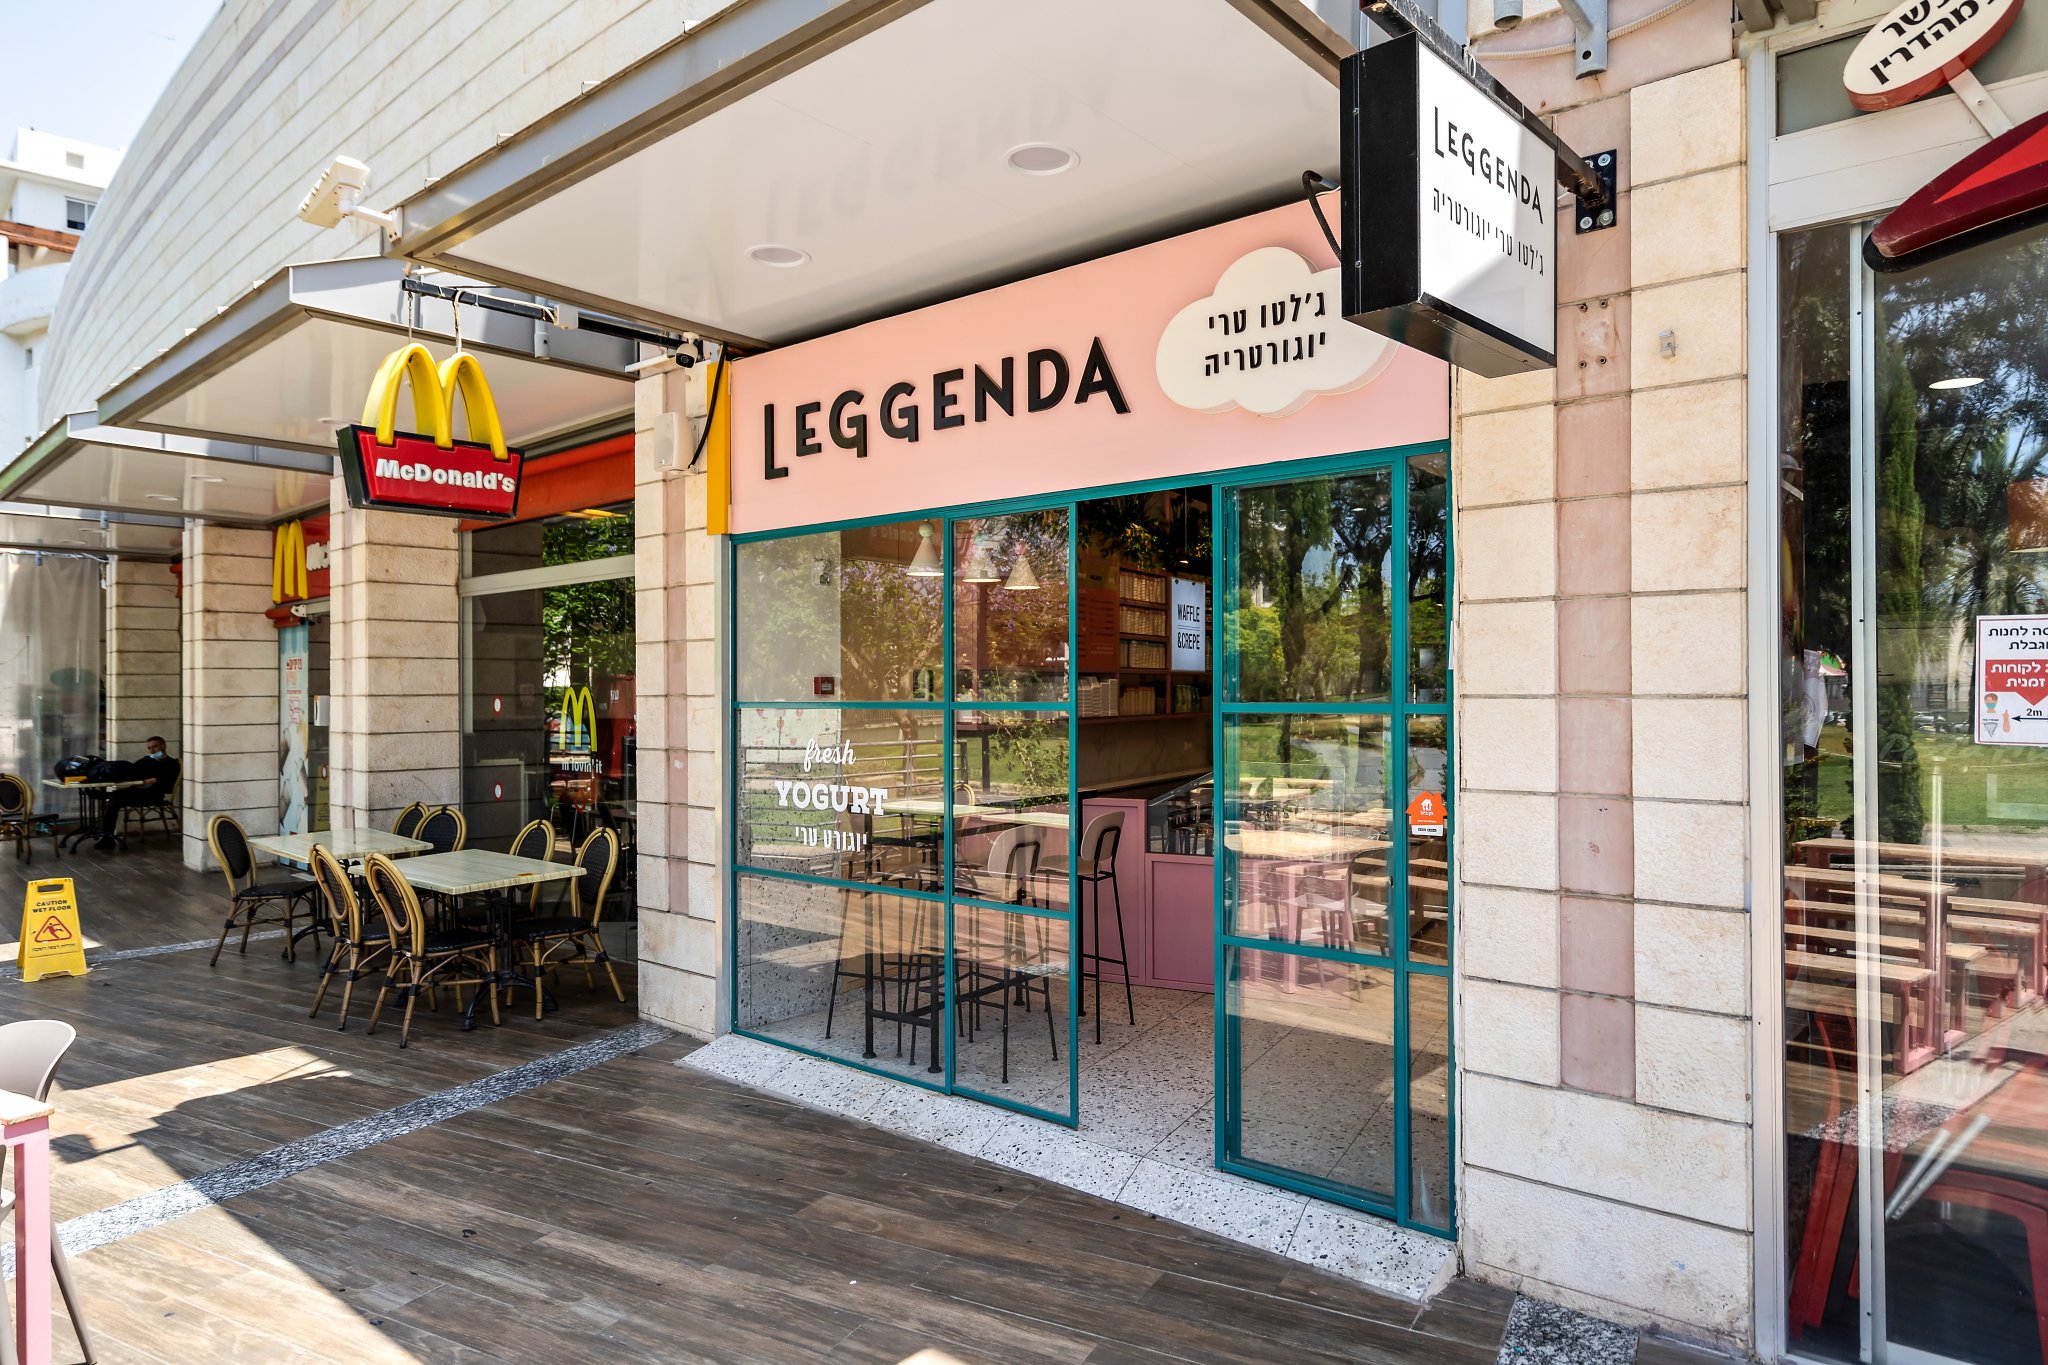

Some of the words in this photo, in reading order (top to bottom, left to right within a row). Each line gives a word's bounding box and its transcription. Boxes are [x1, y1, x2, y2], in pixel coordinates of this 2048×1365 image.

[1881, 0, 1950, 37] שר
[1869, 0, 1997, 85] מהדרין
[1434, 105, 1544, 225] LEGGENDA
[1433, 187, 1490, 241] יוגורטריה
[1495, 226, 1513, 257] טרי
[1208, 309, 1247, 336] טרי
[1204, 331, 1326, 377] יוגורטריה
[764, 335, 1132, 480] LEGGENDA
[375, 458, 516, 493] McDonald's
[1177, 603, 1200, 623] WAFFLE
[1988, 626, 2029, 637] לחנות
[1990, 661, 2042, 675] לקוחות
[2005, 677, 2046, 688] זמנית
[2026, 708, 2043, 717] 2m
[803, 738, 857, 773] fresh
[775, 780, 888, 816] YOGURT
[795, 826, 818, 847] טרי
[823, 829, 868, 852] יוגורט
